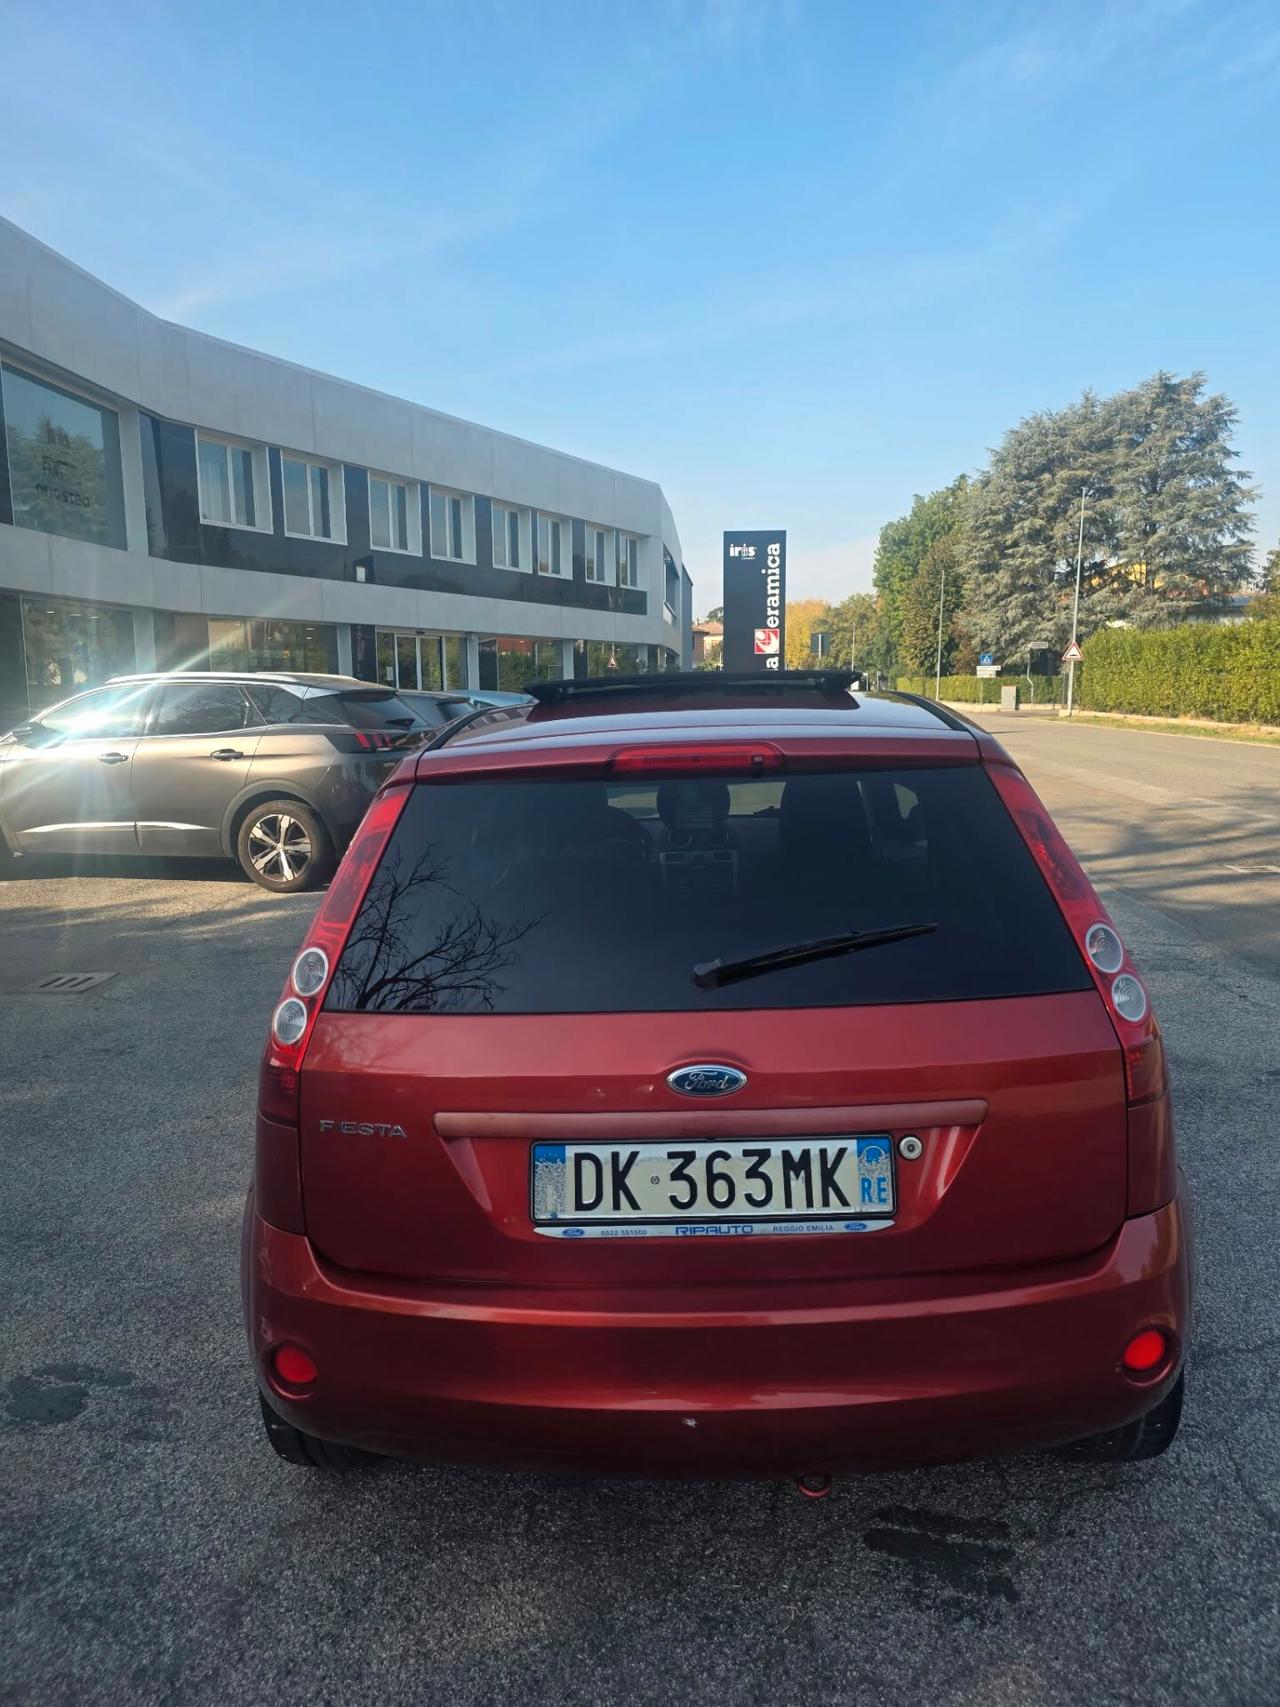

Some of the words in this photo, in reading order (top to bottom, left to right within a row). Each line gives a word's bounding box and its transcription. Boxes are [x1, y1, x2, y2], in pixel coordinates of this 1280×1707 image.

[729, 543, 755, 557] iris
[319, 1119, 408, 1139] FESTA
[573, 1149, 642, 1213] DK
[861, 1175, 888, 1204] RE
[675, 1225, 754, 1236] RIPAUTO
[772, 1225, 804, 1233] REGGIO
